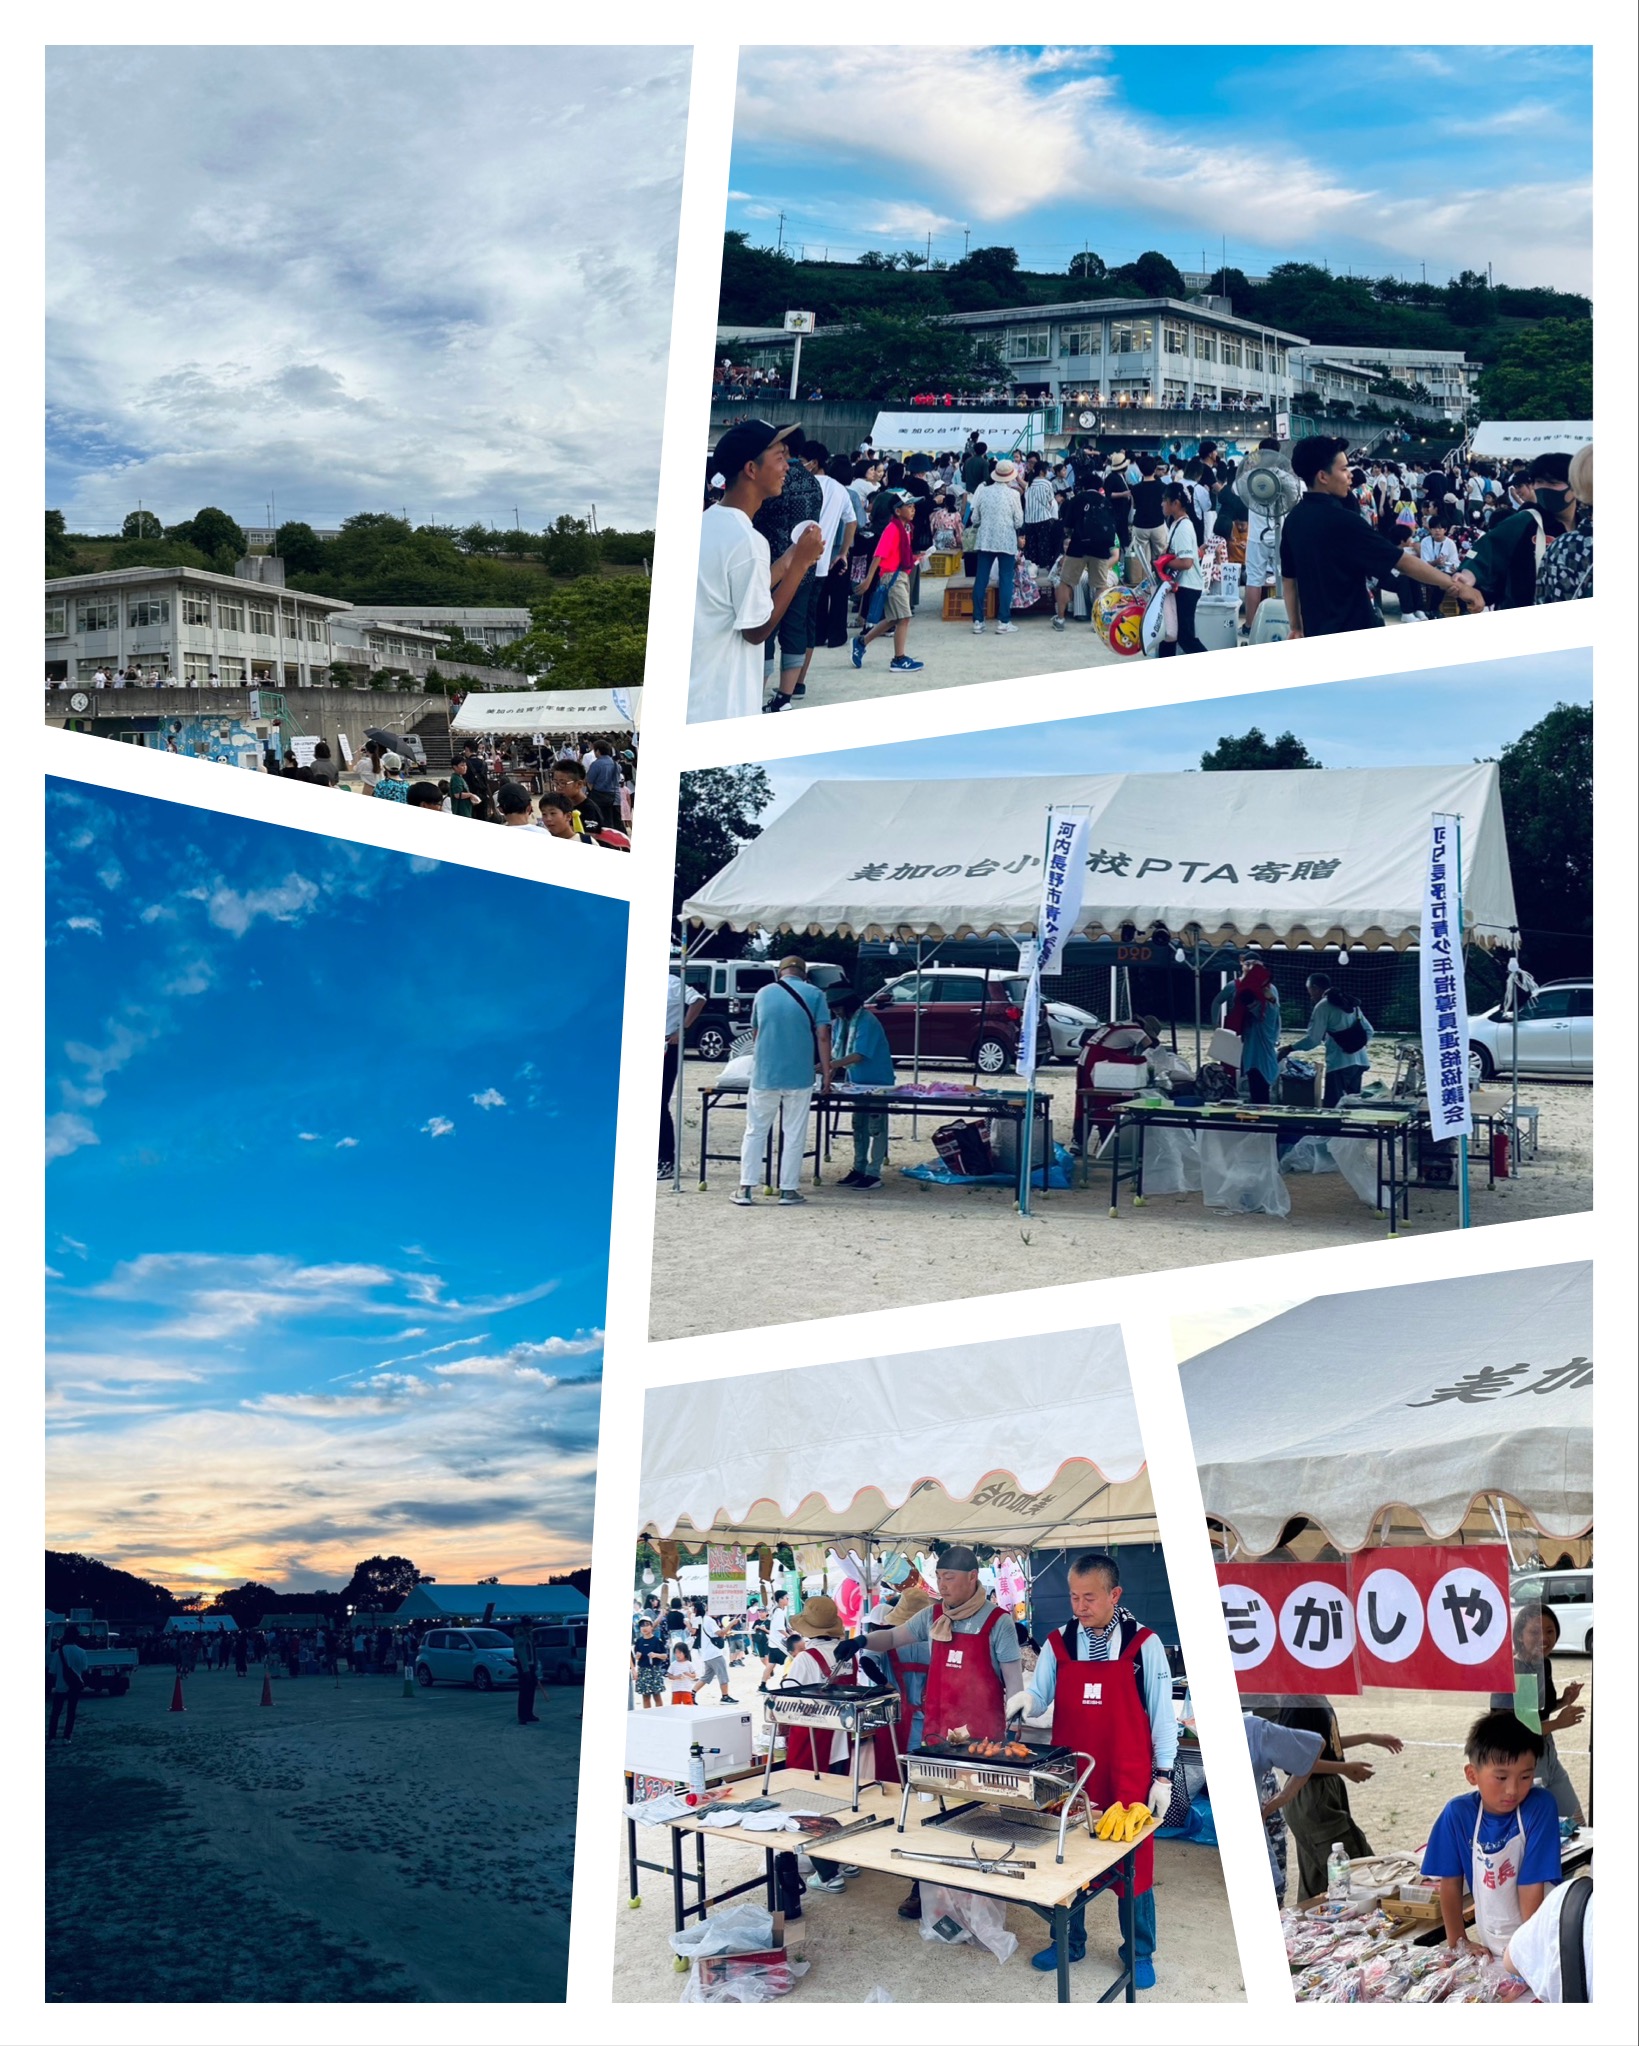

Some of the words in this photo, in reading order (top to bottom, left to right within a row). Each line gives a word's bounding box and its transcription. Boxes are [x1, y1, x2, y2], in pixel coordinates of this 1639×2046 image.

[847, 848, 1343, 884] 美加の台小校PTA寄贈
[1222, 1583, 1494, 1655] だがしや
